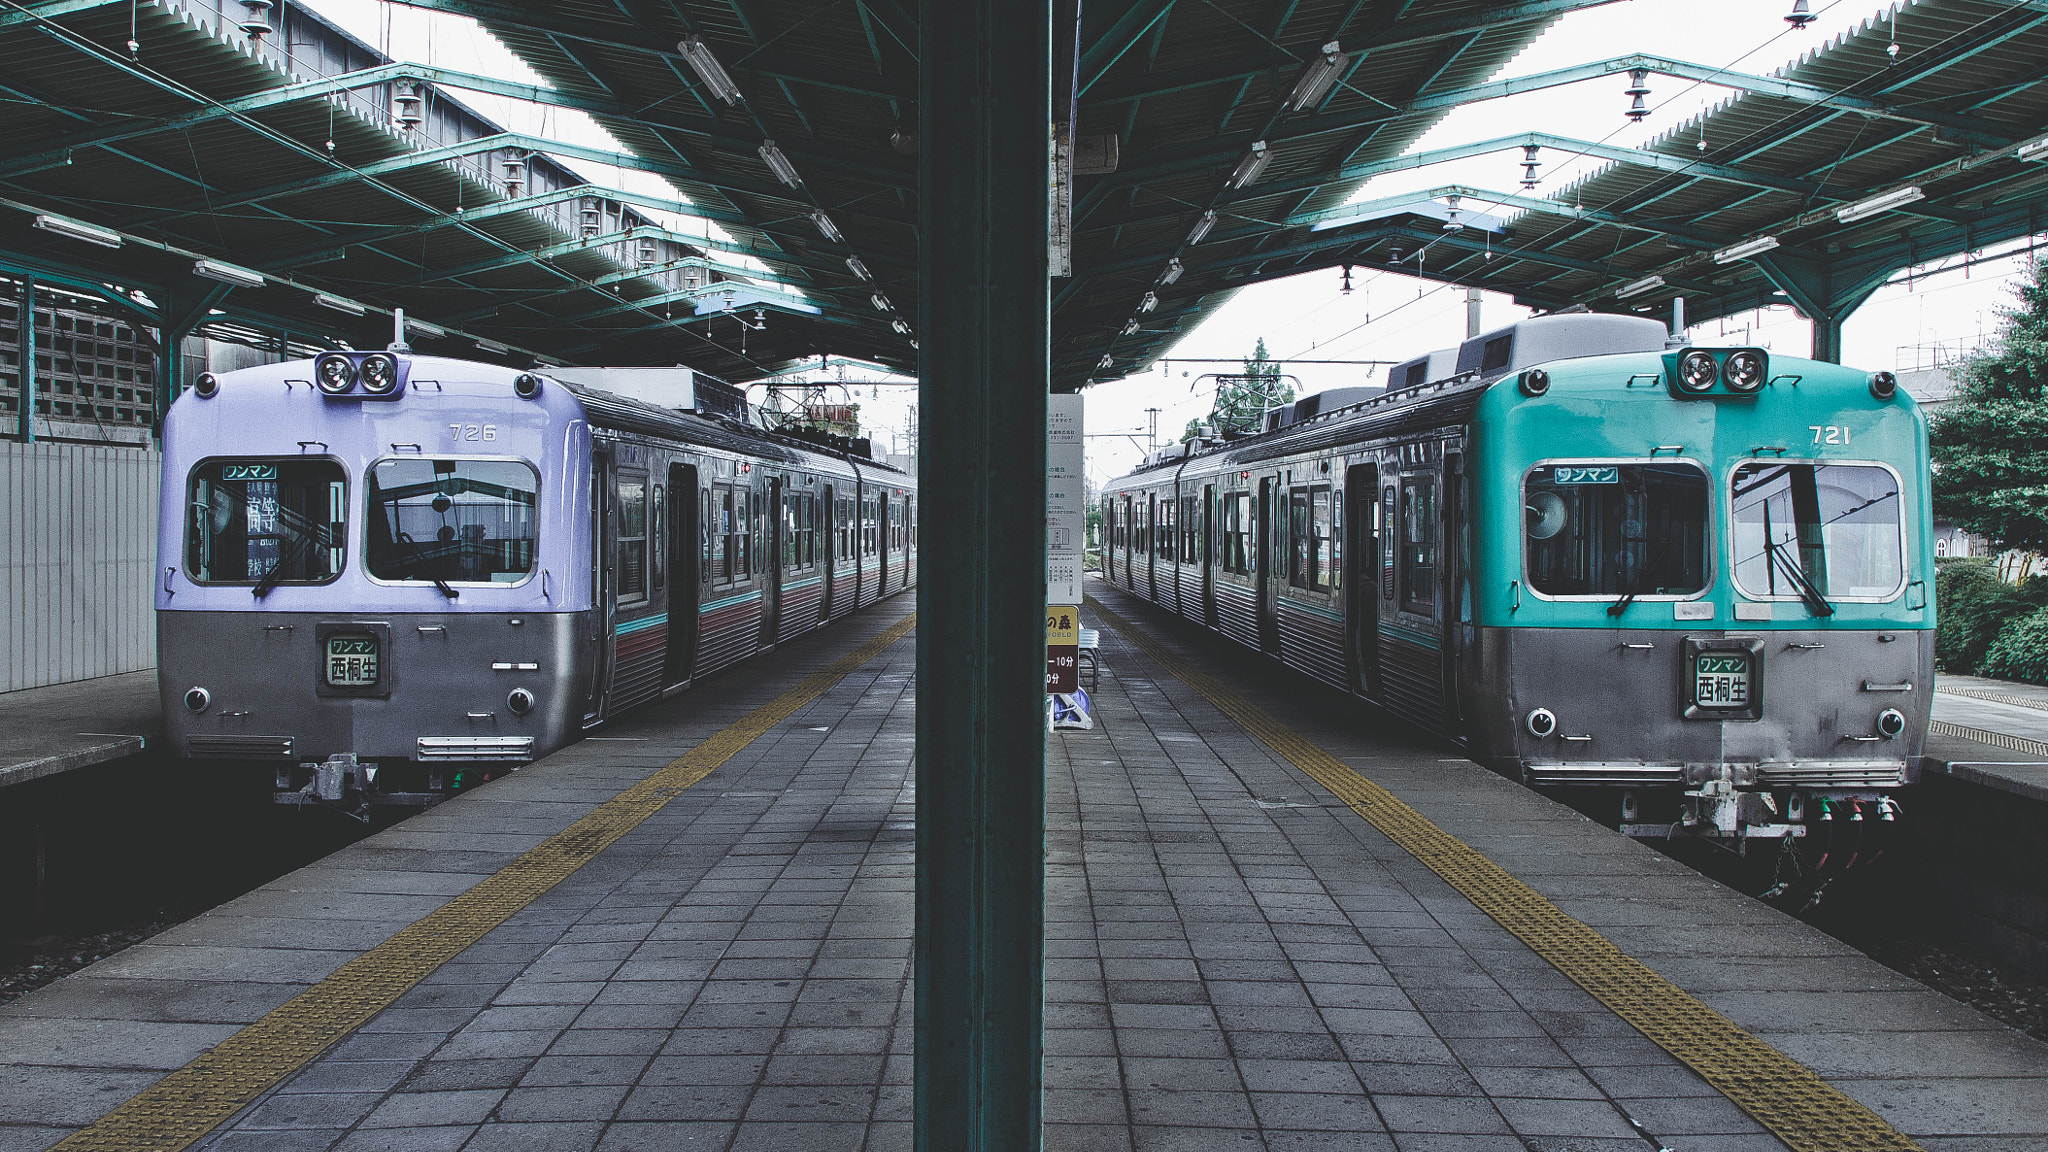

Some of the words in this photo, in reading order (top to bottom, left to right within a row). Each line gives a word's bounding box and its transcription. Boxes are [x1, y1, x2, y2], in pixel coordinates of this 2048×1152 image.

[449, 424, 496, 441] 726
[1808, 425, 1850, 445] 721
[225, 464, 274, 478] ワンマン
[1557, 467, 1616, 482] ワンマン
[1048, 614, 1072, 630] の森
[333, 640, 375, 653] ワンマン
[331, 656, 376, 681] 西桐生
[1700, 658, 1745, 671] ワンマン
[1698, 675, 1747, 702] 西桐生
